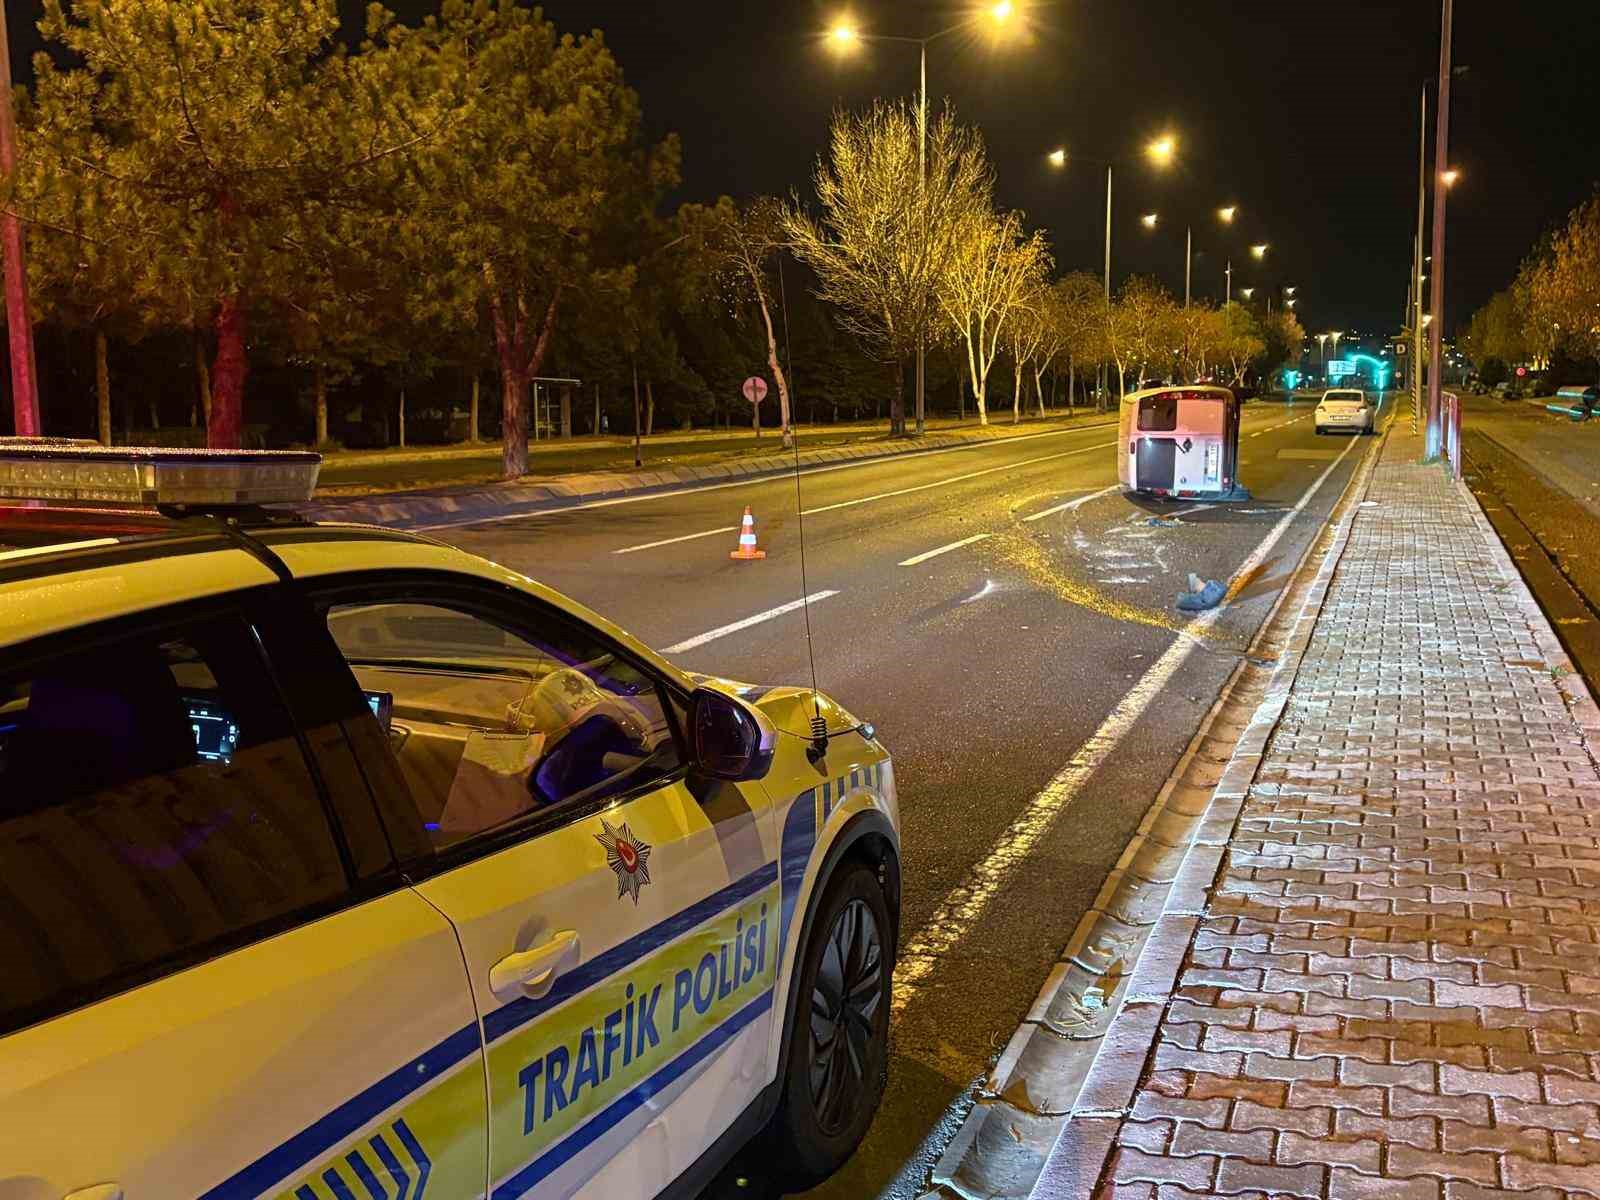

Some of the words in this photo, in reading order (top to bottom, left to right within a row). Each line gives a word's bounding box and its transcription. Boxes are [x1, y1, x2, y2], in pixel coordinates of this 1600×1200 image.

[1396, 344, 1406, 354] D
[518, 983, 662, 1136] TRAFİK
[672, 902, 768, 1032] POLİSİ
